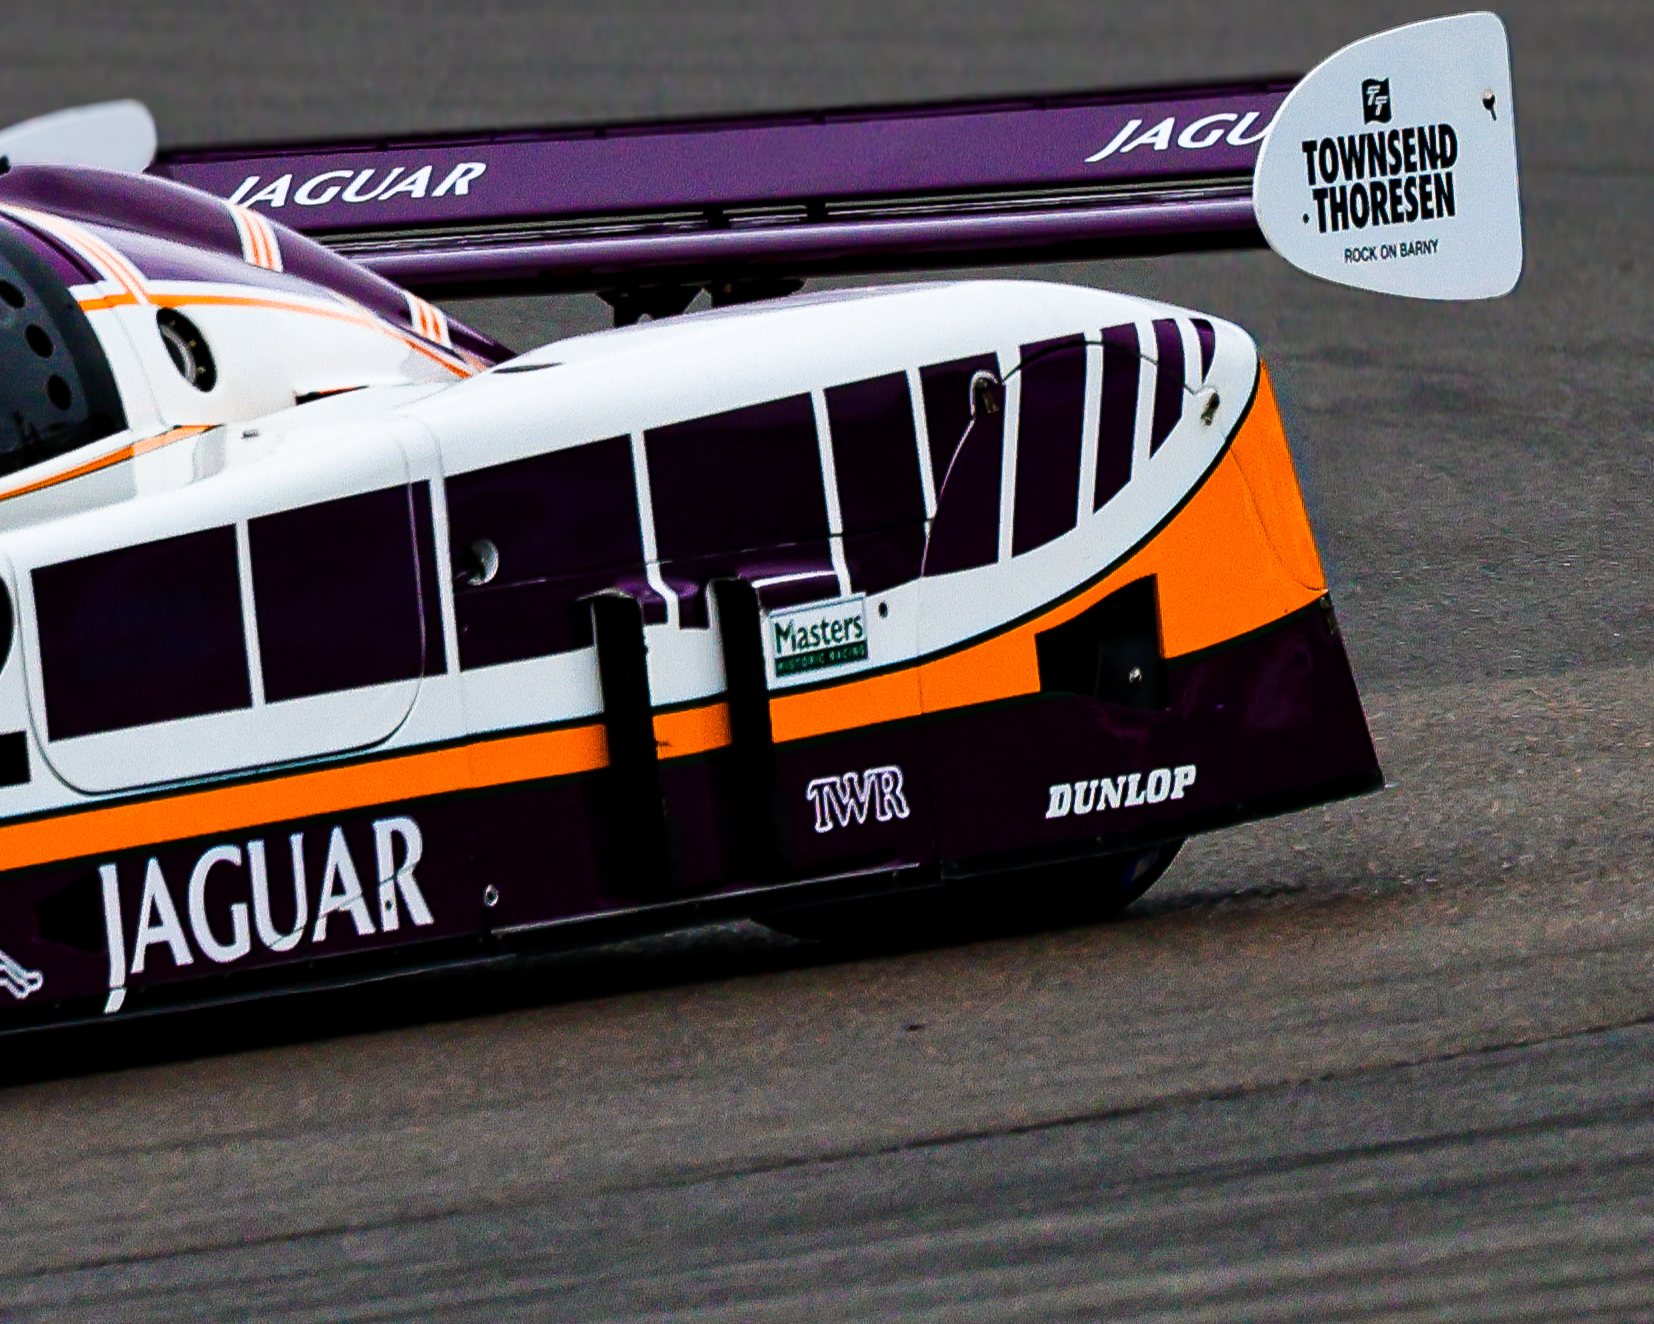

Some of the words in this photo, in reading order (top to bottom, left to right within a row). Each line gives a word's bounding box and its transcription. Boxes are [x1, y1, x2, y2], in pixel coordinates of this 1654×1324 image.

[1301, 123, 1459, 186] TOWNSEND
[228, 161, 487, 209] JAGUAR
[1312, 171, 1457, 234] THORESEN
[1344, 246, 1378, 264] ROCK
[1380, 243, 1397, 260] ON
[1400, 238, 1439, 257] BARNY
[774, 615, 863, 654] Masters
[807, 765, 910, 833] TWR
[1046, 765, 1197, 819] DUNLOP
[98, 816, 435, 1014] JAGUAR
